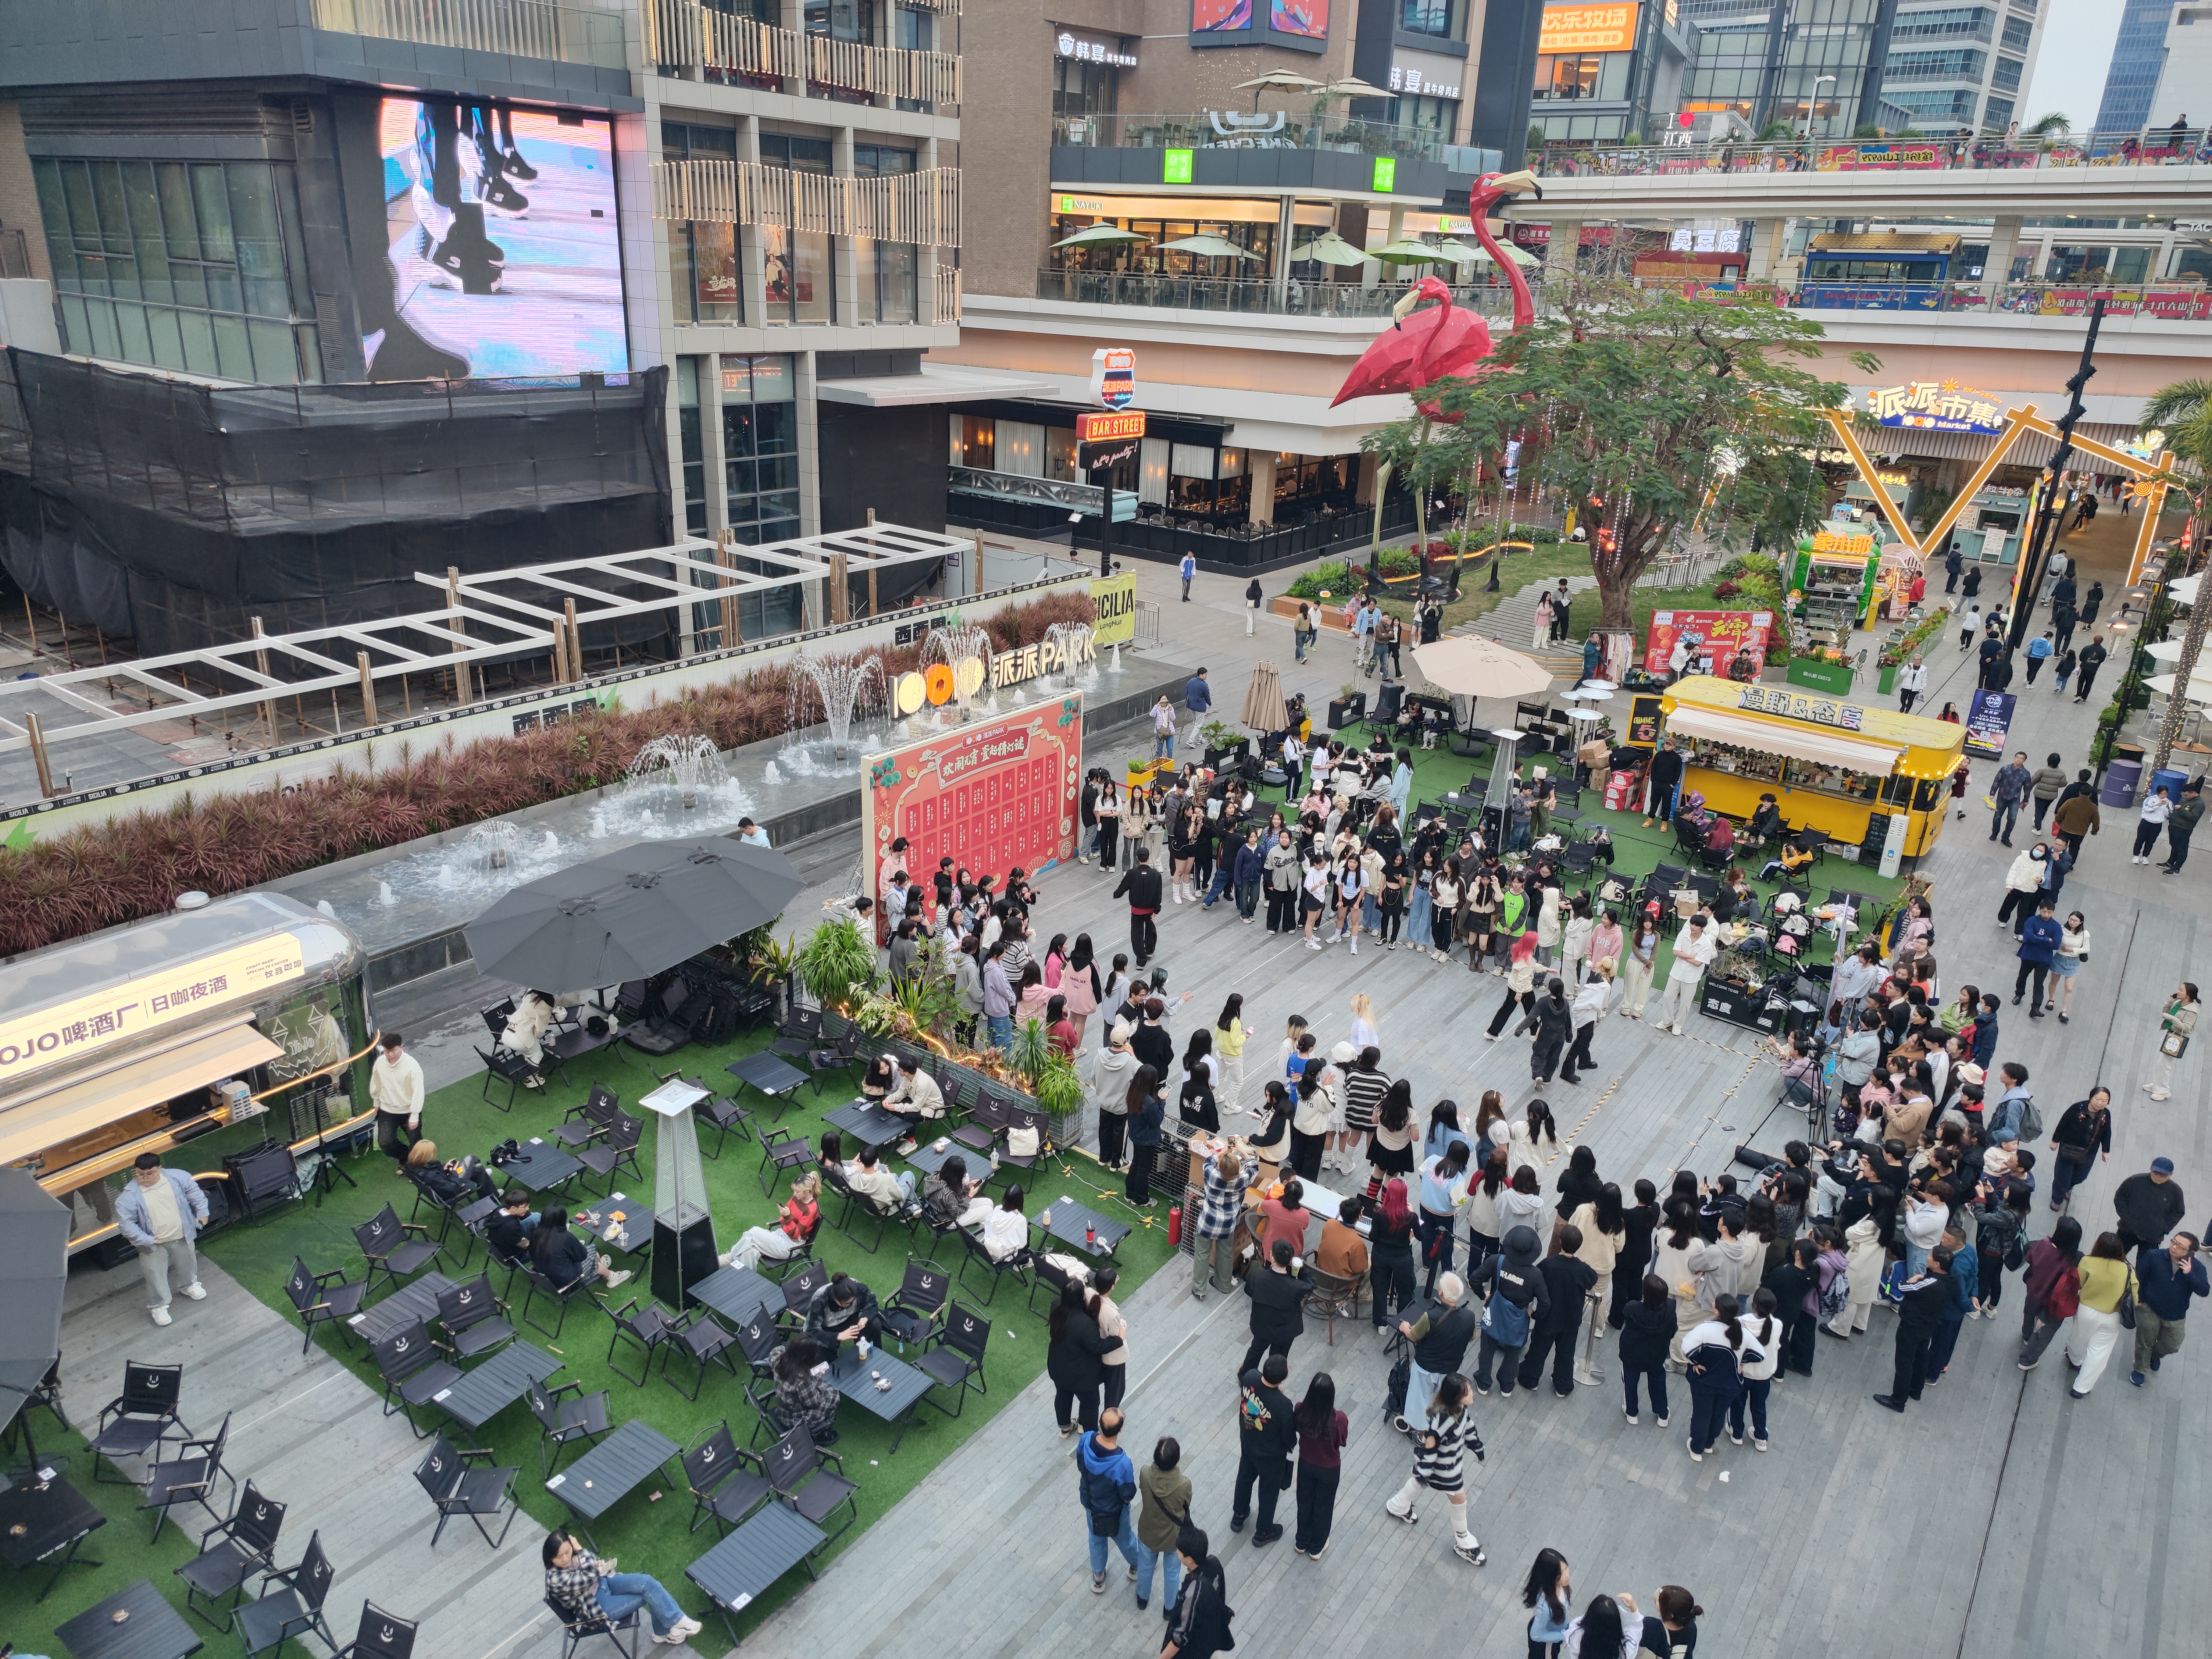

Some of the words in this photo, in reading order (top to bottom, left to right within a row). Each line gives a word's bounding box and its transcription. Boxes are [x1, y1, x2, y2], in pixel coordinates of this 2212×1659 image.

[1542, 8, 1628, 31] 欢乐牧场
[1543, 37, 1558, 45] 毛肚
[1563, 36, 1577, 44] 火锅
[1583, 35, 1598, 43] 烤肉
[1076, 41, 1105, 61] 韩宴
[1107, 53, 1137, 65] 黑牛烤肉店
[1423, 82, 1459, 97] 黑牛烤肉店
[1074, 200, 1103, 210] NAYUKI
[1449, 221, 1471, 230] NAYUKI
[2189, 223, 2212, 232] TAC
[1671, 229, 1741, 253] 臭豆腐
[1866, 380, 1998, 427] 派派市集
[1092, 421, 1110, 436] BAR
[1113, 418, 1144, 435] STREET
[1938, 421, 1971, 430] Market
[361, 730, 376, 738] SICILIA
[299, 744, 315, 752] SICILIA
[943, 748, 977, 777] 欢闹元宵
[981, 736, 1025, 763] 壹起猜灯谜
[233, 758, 250, 767] SICILIA
[163, 774, 181, 783] SICILIA
[88, 790, 107, 800] SICILIA
[9, 808, 29, 818] SICILIA
[247, 964, 271, 975] SPECIALTY
[271, 959, 289, 967] COFFEE
[1709, 982, 1728, 991] WELCOME
[151, 974, 228, 1014] 日咖夜酒
[1706, 998, 1732, 1015] 态度
